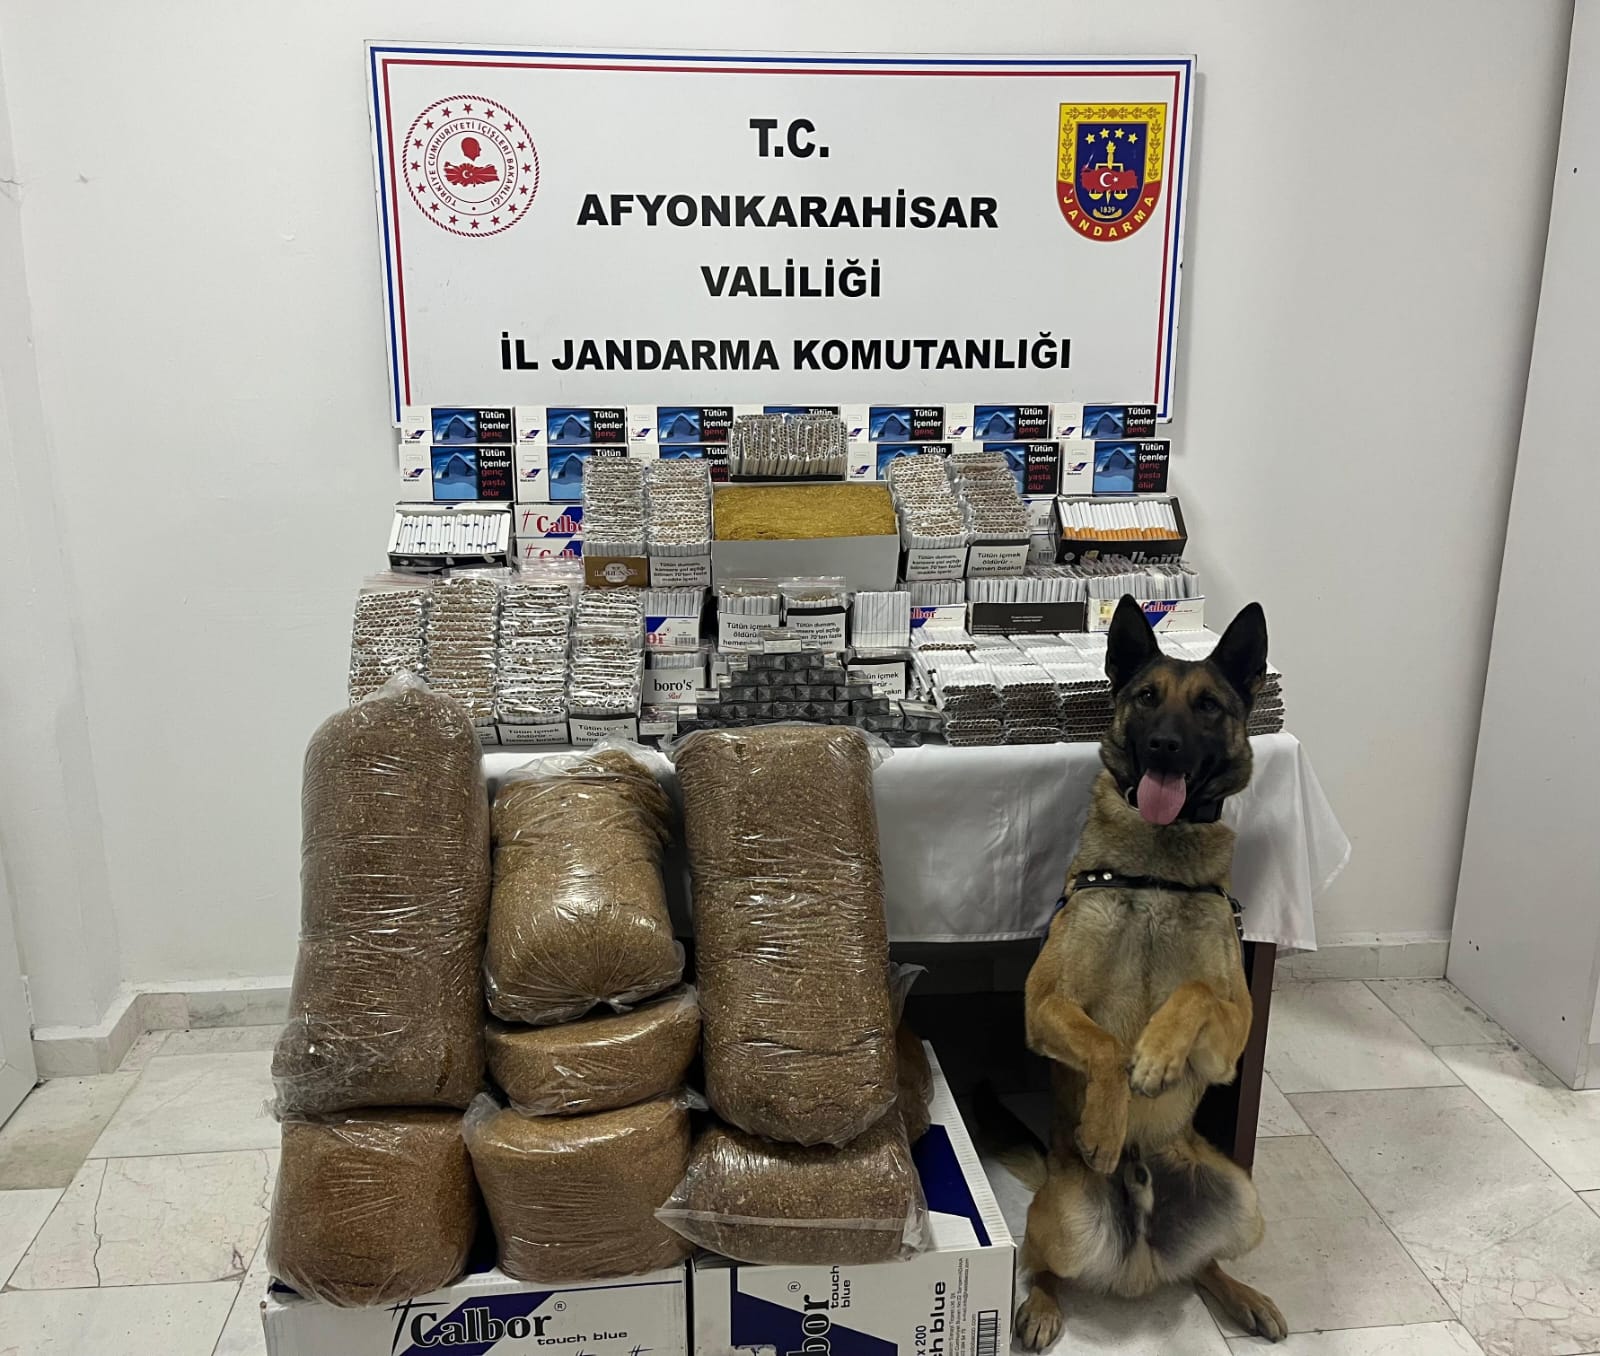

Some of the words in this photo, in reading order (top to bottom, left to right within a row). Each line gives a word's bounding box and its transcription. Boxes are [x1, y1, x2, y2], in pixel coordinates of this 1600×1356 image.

[477, 122, 513, 156] İÇİŞLERİ
[749, 118, 829, 158] T.C.
[427, 121, 475, 166] CUMHURİYETİ
[490, 158, 515, 207] BAKANLIĞI
[577, 188, 999, 228] AFYONKARAHİSAR
[1063, 196, 1154, 237] JANDARMA
[700, 258, 881, 298] VALİLİĞİ
[500, 331, 538, 371] İL
[552, 339, 780, 371] JANDARMA
[793, 331, 1071, 370] KOMUTANLIĞI
[479, 411, 505, 419] Tütün
[593, 411, 619, 419] Tütün
[702, 409, 728, 417] Tütün
[914, 409, 938, 417] Tütün
[1018, 407, 1043, 415] Tütün
[1127, 407, 1151, 415] Tütün
[479, 422, 510, 430] içenler
[594, 421, 624, 430] içenler
[703, 419, 732, 428] içenler
[914, 419, 942, 428] içenler
[1018, 418, 1047, 426] içenler
[1127, 417, 1155, 426] içenler
[922, 446, 947, 454] Tütün
[1028, 444, 1053, 452] Tütün
[1139, 443, 1164, 451] Tütün
[479, 448, 505, 457] Tütün
[595, 449, 621, 457] Tütün
[1028, 455, 1057, 463] içenler
[1138, 453, 1168, 462] içenler
[480, 459, 511, 468] içenler
[911, 607, 937, 619] lbor
[877, 671, 899, 680] içmek
[654, 678, 692, 692] boro's
[830, 1265, 839, 1309] touch
[841, 1279, 851, 1308] blue
[929, 1281, 946, 1334] blue
[410, 1306, 553, 1347] Calbor
[537, 1334, 587, 1345] touch
[593, 1331, 628, 1341] blue
[915, 1325, 927, 1346] 200
